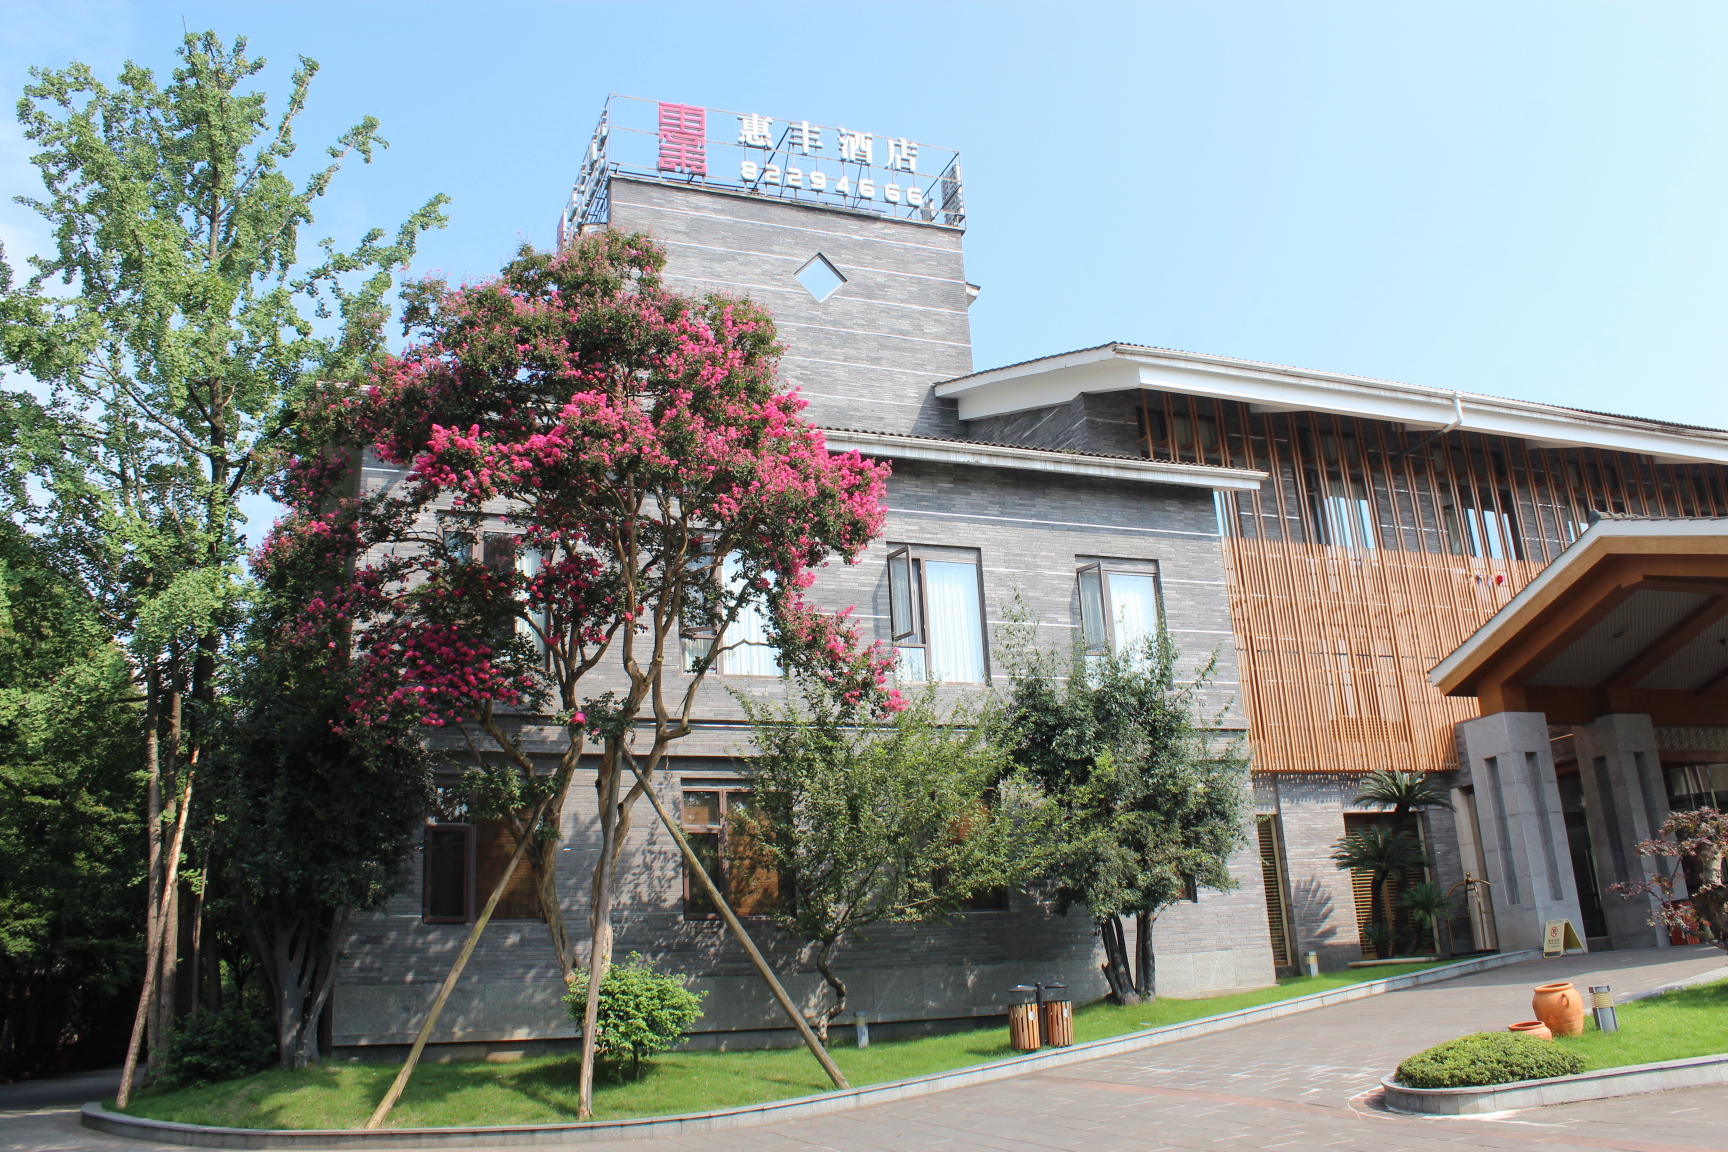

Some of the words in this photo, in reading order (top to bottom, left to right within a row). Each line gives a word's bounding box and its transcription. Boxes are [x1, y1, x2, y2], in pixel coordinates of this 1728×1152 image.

[737, 113, 919, 173] 惠丰酒店
[740, 160, 923, 208] 82294666
